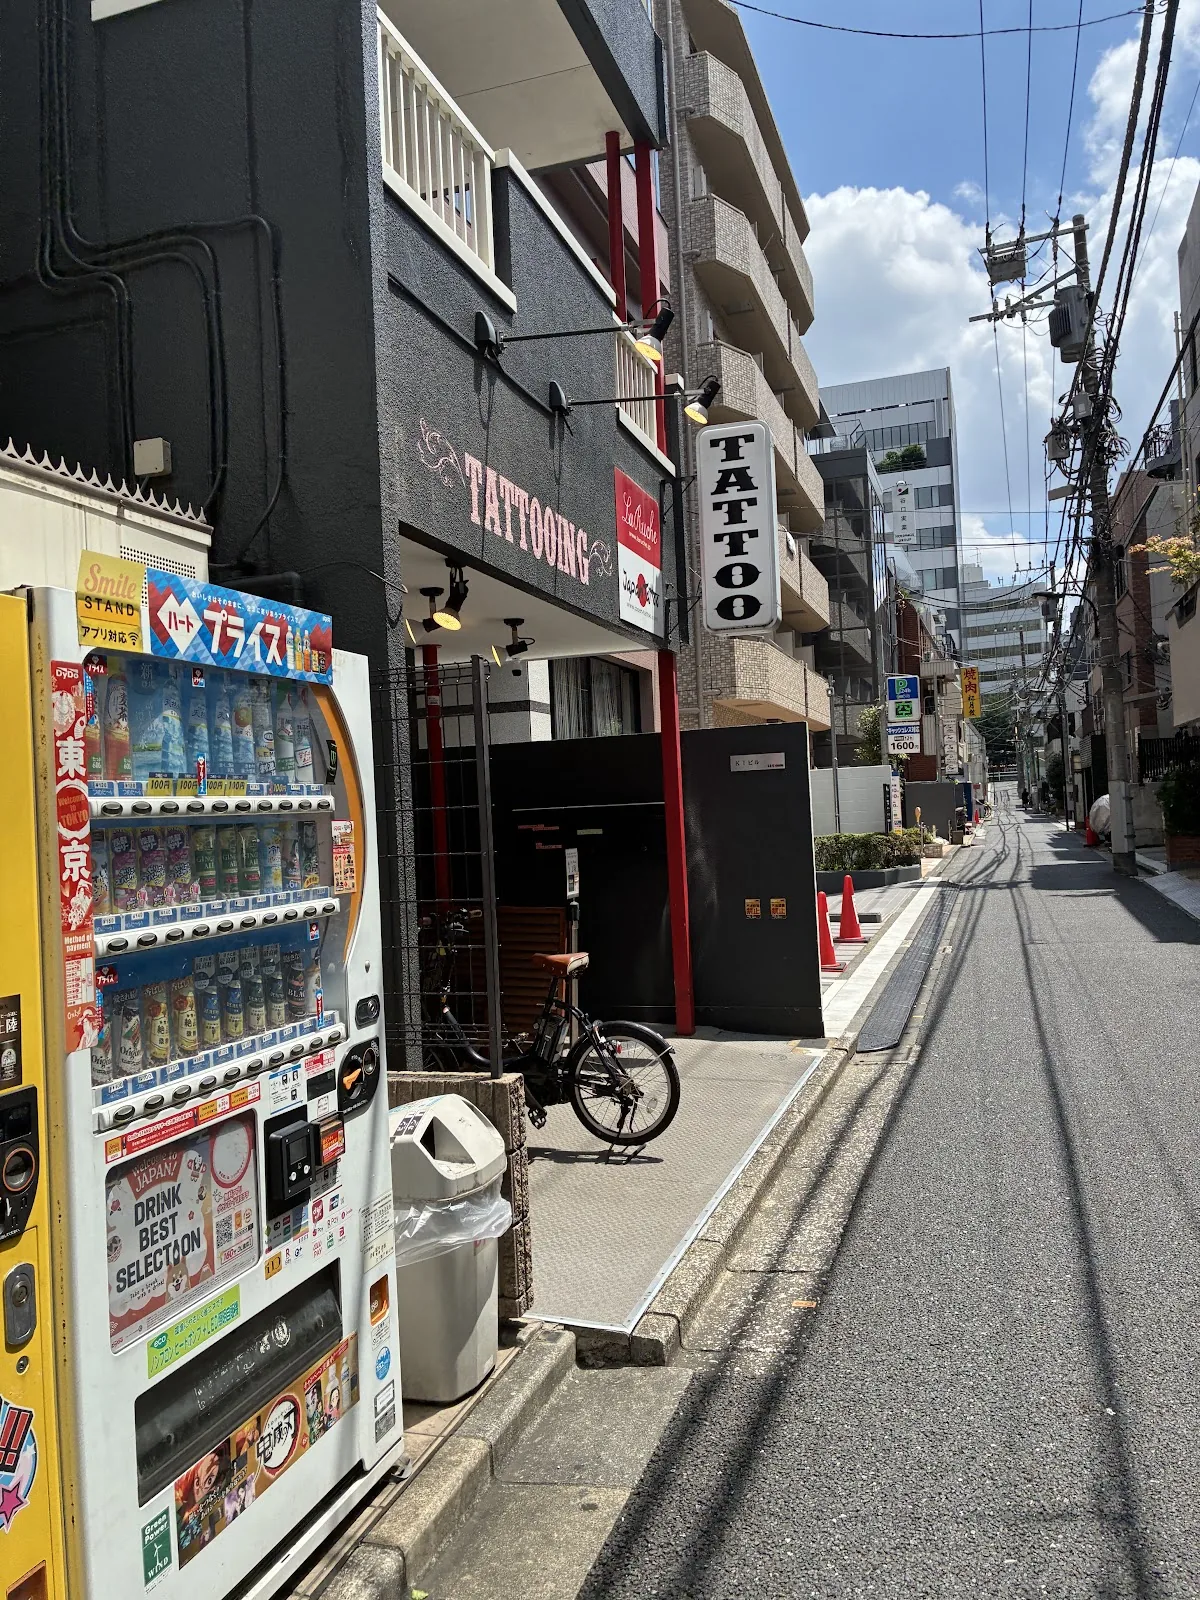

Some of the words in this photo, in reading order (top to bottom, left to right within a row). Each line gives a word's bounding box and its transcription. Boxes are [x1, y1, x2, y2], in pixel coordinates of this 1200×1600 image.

[465, 452, 589, 586] TATTOOING
[709, 433, 763, 621] TATTOO
[84, 563, 137, 600] Smile
[84, 595, 134, 617] STAND
[168, 611, 194, 633] ハート
[81, 625, 128, 644] アプリ対応
[203, 609, 283, 666] プライス
[55, 667, 79, 679] DyDo
[963, 668, 977, 694] 焼肉
[55, 735, 87, 779] 東
[60, 809, 88, 827] TOKYO
[60, 840, 91, 883] 京
[64, 933, 86, 945] Method
[86, 933, 92, 942] of
[66, 941, 91, 952] payment
[168, 1151, 177, 1161] to
[135, 1161, 177, 1194] JAPAN!
[134, 1183, 182, 1228] DRINK
[138, 1211, 178, 1253] BEST
[153, 1335, 167, 1348] eco
[256, 1406, 297, 1464] 鬼滅の刃
[144, 1514, 167, 1535] Green
[144, 1521, 168, 1545] Power
[148, 1556, 169, 1579] WIND
